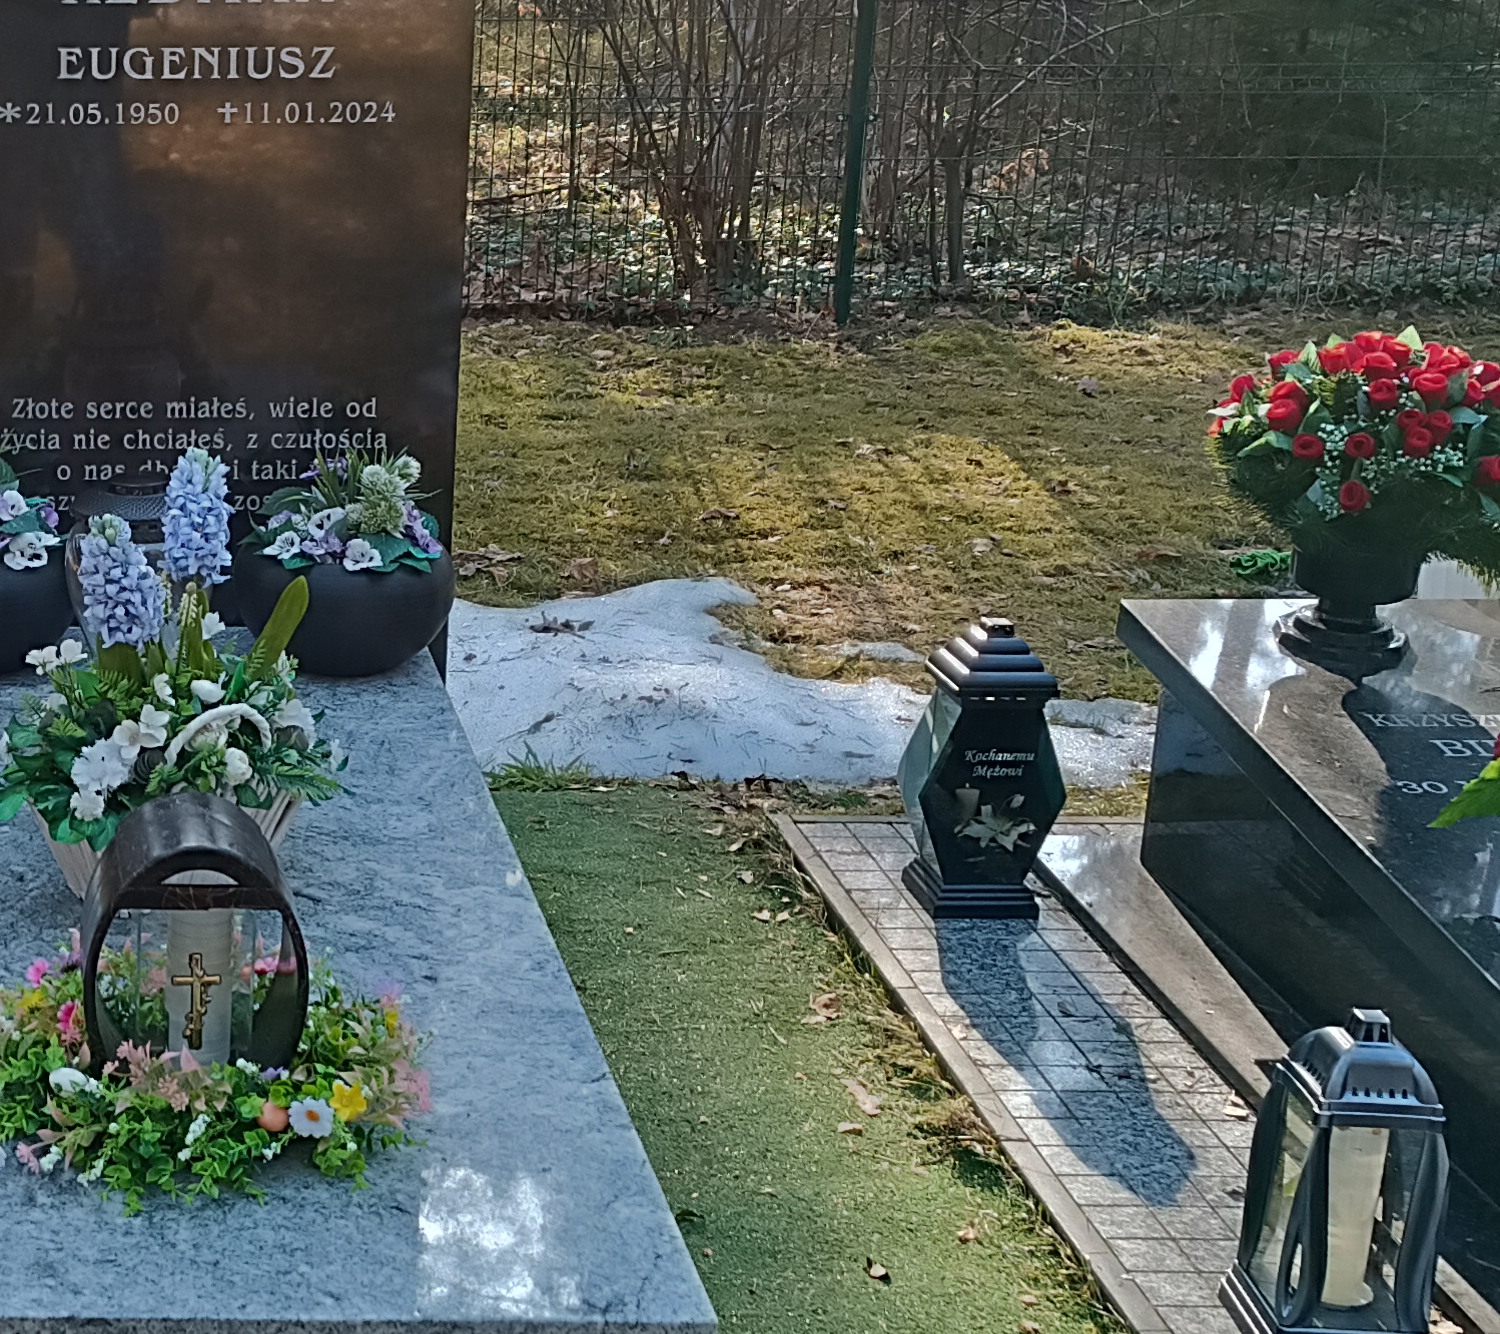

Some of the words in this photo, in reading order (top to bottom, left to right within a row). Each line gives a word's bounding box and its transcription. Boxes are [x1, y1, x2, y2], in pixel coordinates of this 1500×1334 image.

[56, 46, 337, 80] EUGENIUSZ
[11, 397, 74, 419] Złote
[85, 400, 154, 419] serce
[166, 396, 255, 421] miałeś,
[269, 396, 334, 418] wiele
[346, 397, 378, 418] od
[0, 428, 61, 455] życia
[72, 428, 111, 450] nie
[123, 428, 233, 451] chciałeś,
[246, 432, 259, 449] z
[270, 428, 388, 452] czułością
[56, 464, 71, 481] o
[251, 459, 298, 480] taki
